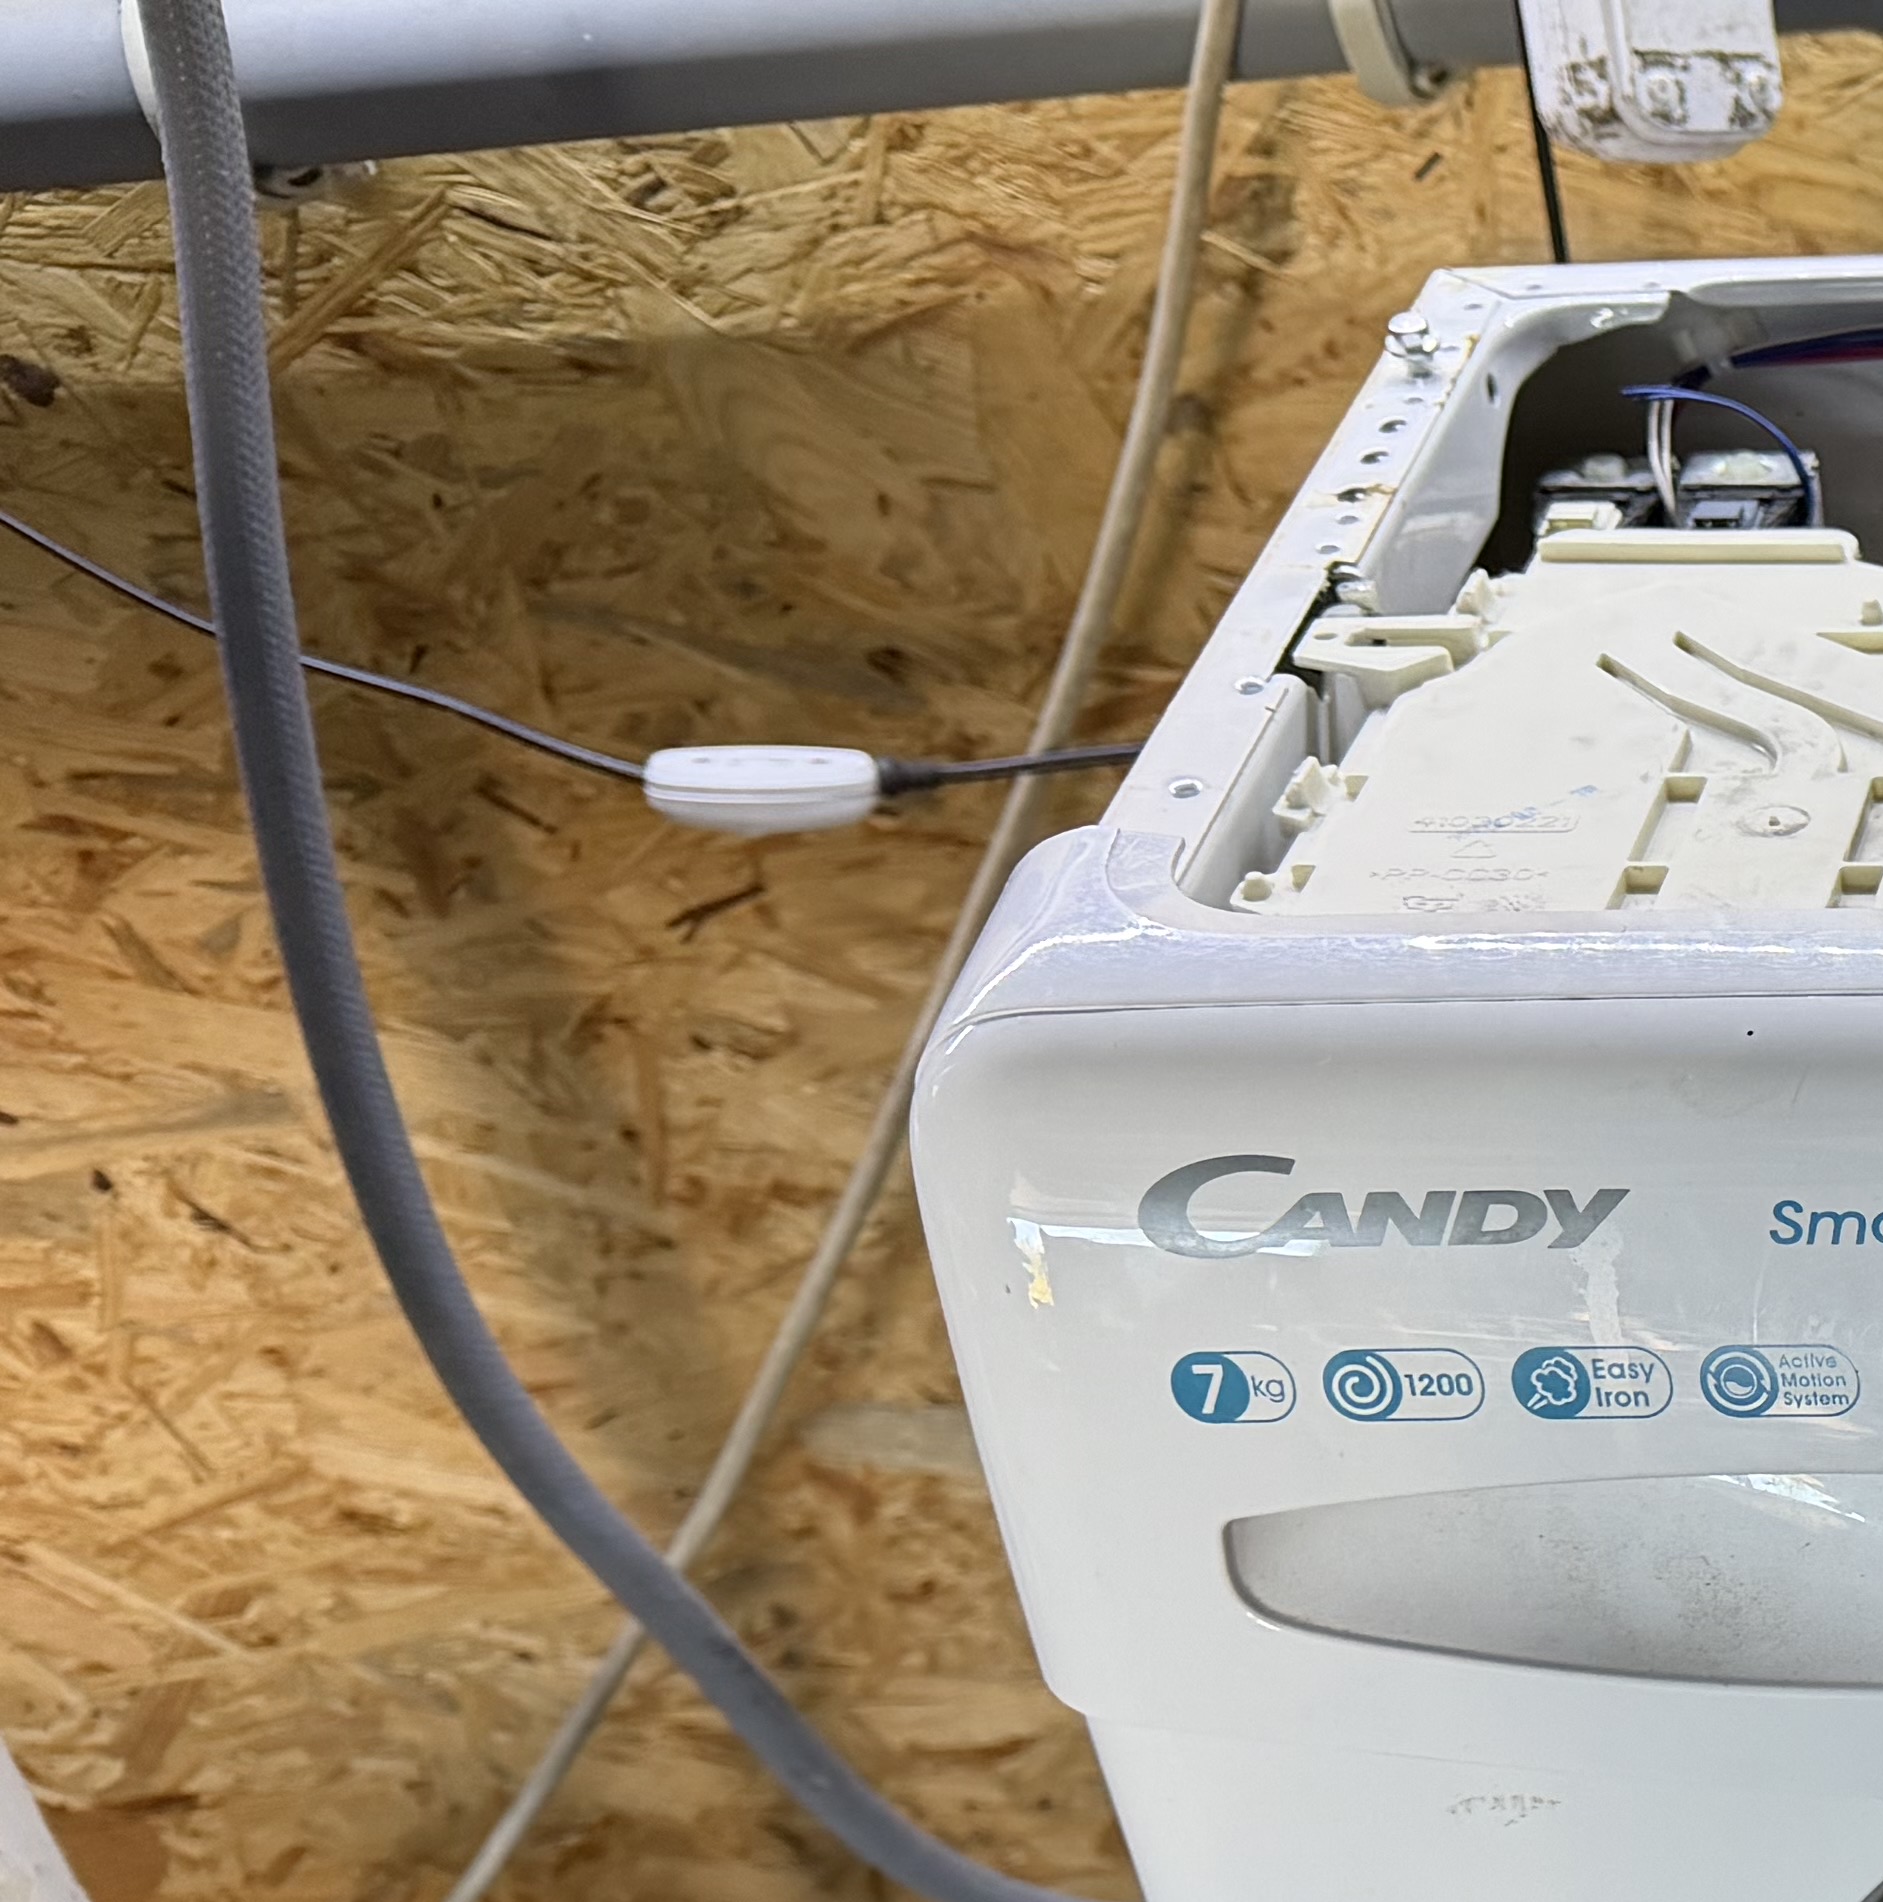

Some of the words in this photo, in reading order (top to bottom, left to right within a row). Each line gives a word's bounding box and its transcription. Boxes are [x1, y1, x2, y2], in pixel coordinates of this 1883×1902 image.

[1137, 1153, 1631, 1259] CANDY
[1591, 1357, 1655, 1387] Easy
[1778, 1352, 1837, 1370] Active
[1191, 1364, 1225, 1415] 7
[1252, 1374, 1286, 1403] kg
[1404, 1373, 1475, 1398] 1200
[1781, 1372, 1847, 1388] Motion
[1596, 1387, 1651, 1409] Iron
[1784, 1390, 1850, 1409] System
